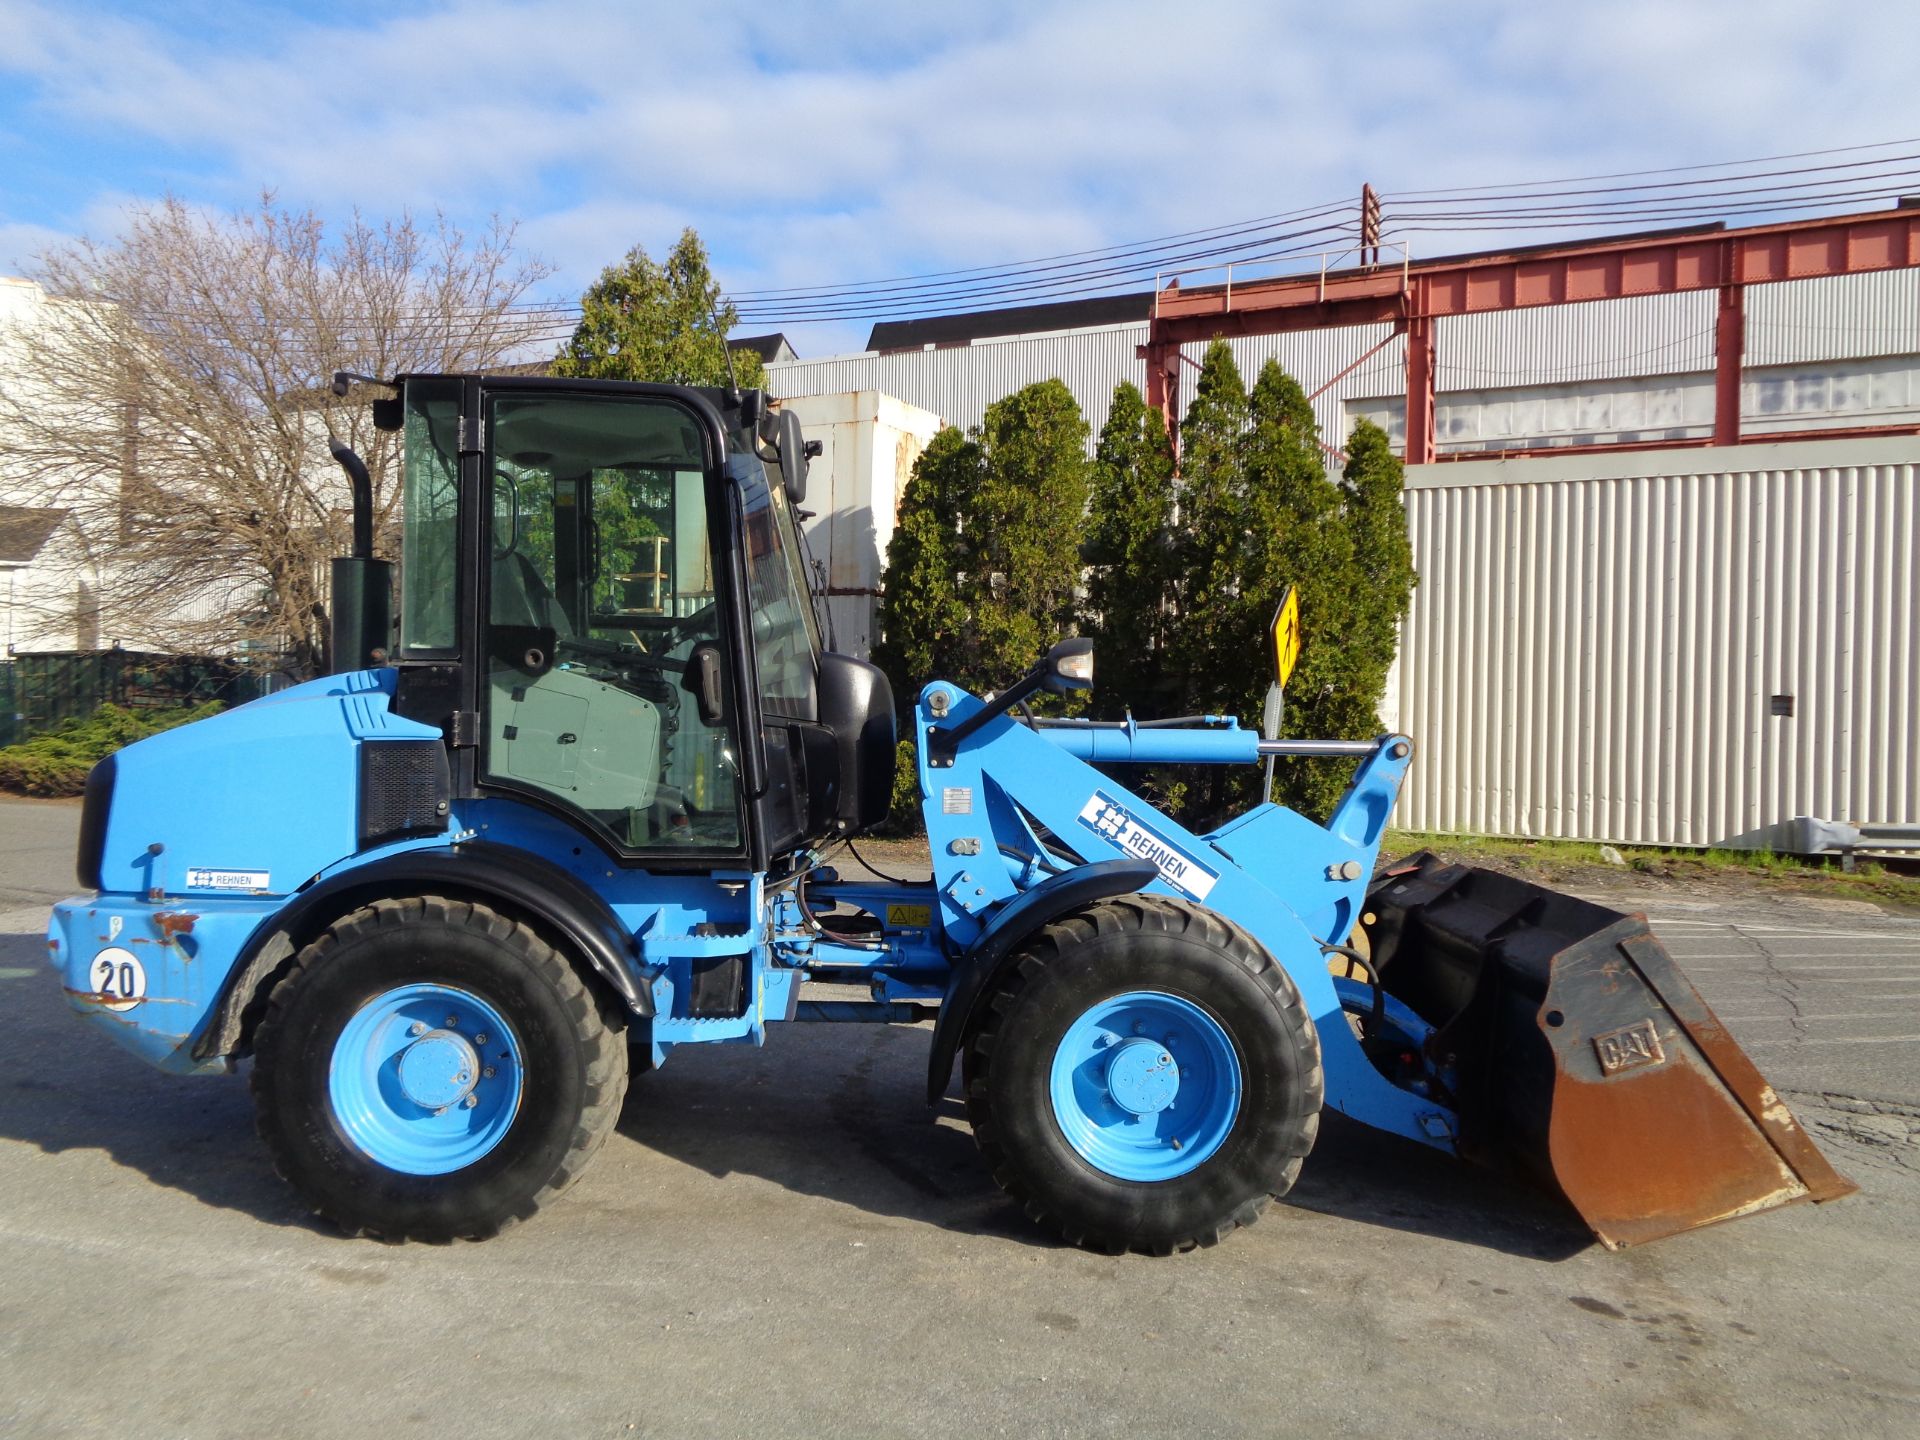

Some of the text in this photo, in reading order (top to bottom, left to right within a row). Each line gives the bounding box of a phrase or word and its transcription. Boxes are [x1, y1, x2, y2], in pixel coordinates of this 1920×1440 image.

[1127, 831, 1188, 879] REHNEN
[216, 875, 252, 885] REHNEN
[99, 960, 135, 998] 20
[1599, 1026, 1652, 1070] CAT
